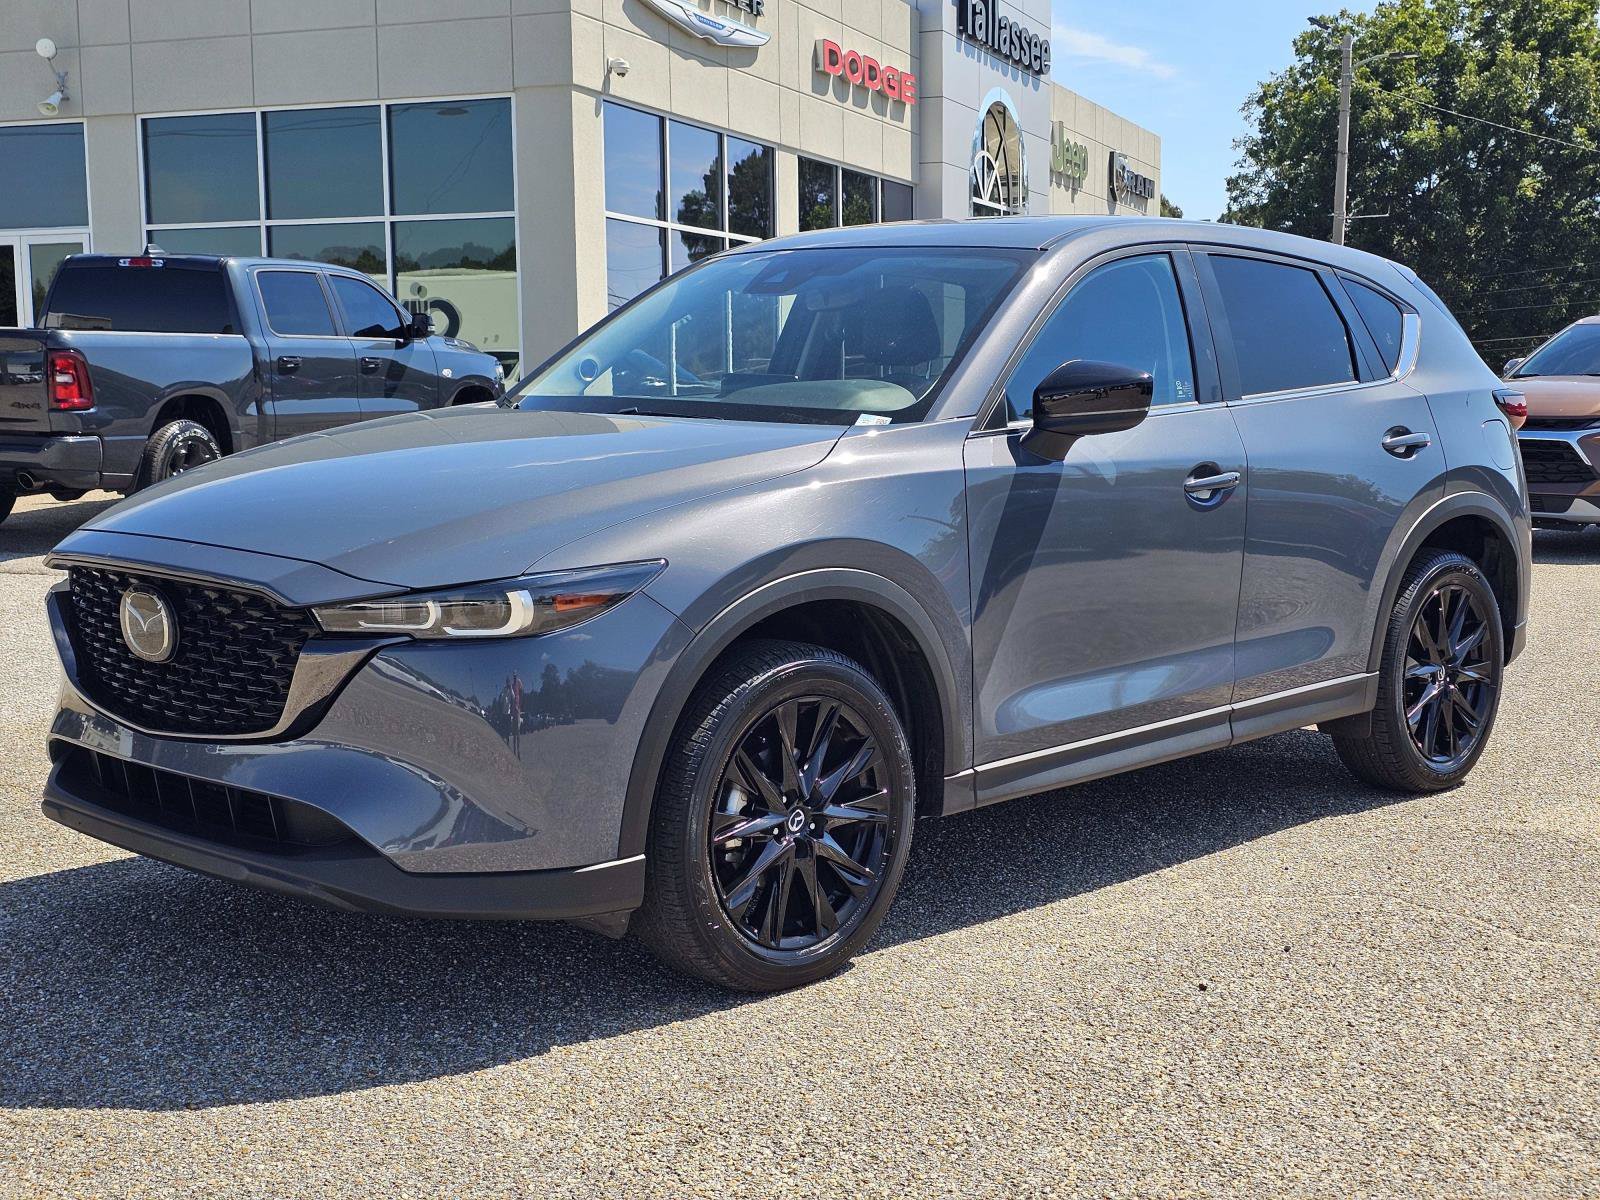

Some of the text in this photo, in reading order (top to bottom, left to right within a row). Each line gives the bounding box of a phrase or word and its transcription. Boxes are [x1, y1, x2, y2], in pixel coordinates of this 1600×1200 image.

[822, 38, 917, 105] DODGE
[1052, 121, 1088, 181] Jeep
[1126, 170, 1155, 200] RAM
